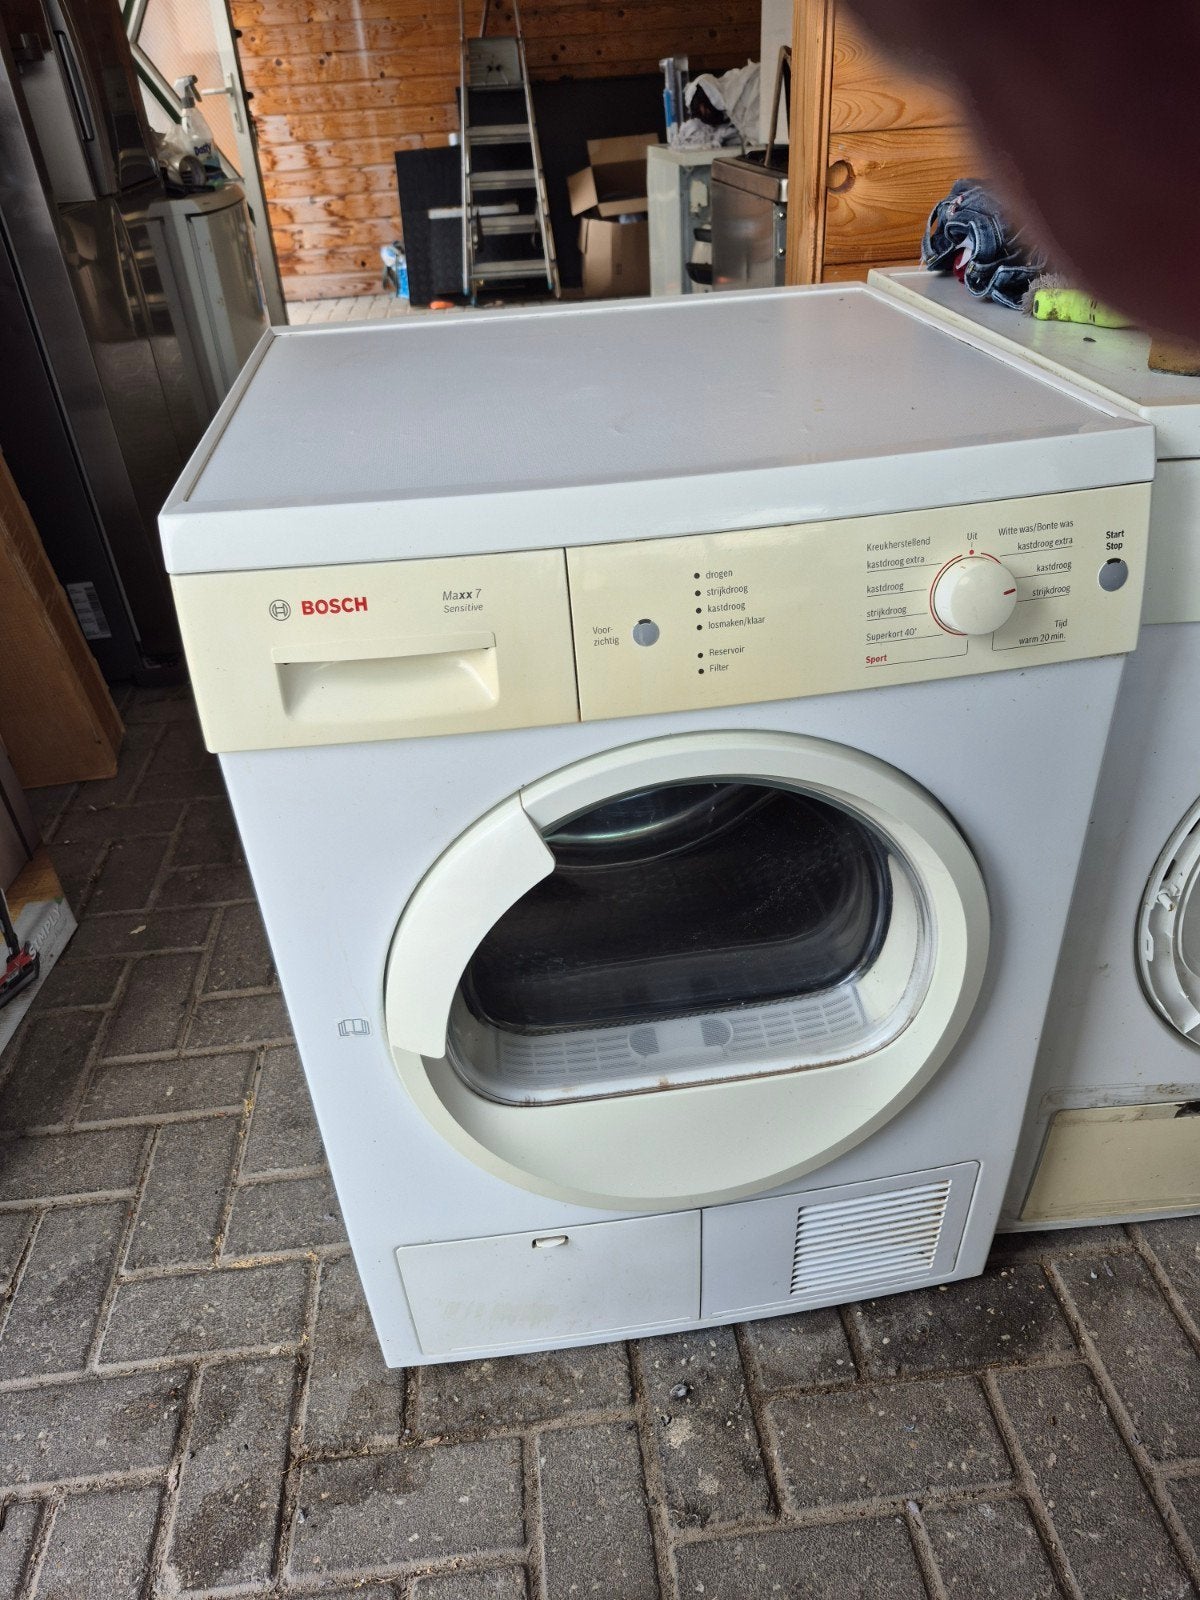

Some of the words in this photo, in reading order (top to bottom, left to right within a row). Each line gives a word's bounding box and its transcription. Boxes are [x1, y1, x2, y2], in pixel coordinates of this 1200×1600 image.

[998, 526, 1018, 536] Witte
[1019, 522, 1058, 534] was/Bonte
[1059, 520, 1074, 529] was
[1105, 529, 1125, 539] Start
[967, 532, 978, 541] Uit
[866, 537, 931, 552] Kreukherstellend
[1017, 538, 1054, 551] kastdroog
[1055, 537, 1073, 546] extra
[1105, 541, 1123, 551] Stop
[866, 557, 904, 570] kastdroog
[905, 555, 925, 566] extra
[1036, 561, 1072, 572] kastdroog
[705, 569, 733, 580] drogen
[706, 584, 749, 597] strijkdroog
[866, 582, 904, 594] kastdroog
[1032, 585, 1071, 597] strijkdroog
[442, 590, 473, 601] Maxx
[475, 588, 482, 598] 7
[301, 596, 368, 615] BOSCH
[443, 602, 484, 613] Sensitive
[707, 602, 746, 614] kastdroog
[866, 606, 907, 618] strijkdroog
[708, 616, 766, 630] losmaken/klaar
[1055, 619, 1068, 629] Tijd
[592, 626, 614, 635] Voor-
[866, 630, 903, 643] Superkort
[593, 636, 620, 648] zichtig
[1019, 635, 1039, 645] warm
[1040, 634, 1050, 644] 20
[1051, 632, 1066, 642] min.
[709, 645, 746, 657] Reservoir
[865, 654, 887, 665] Sport
[709, 663, 730, 673] Filter
[28, 905, 61, 961] SIMPLY
